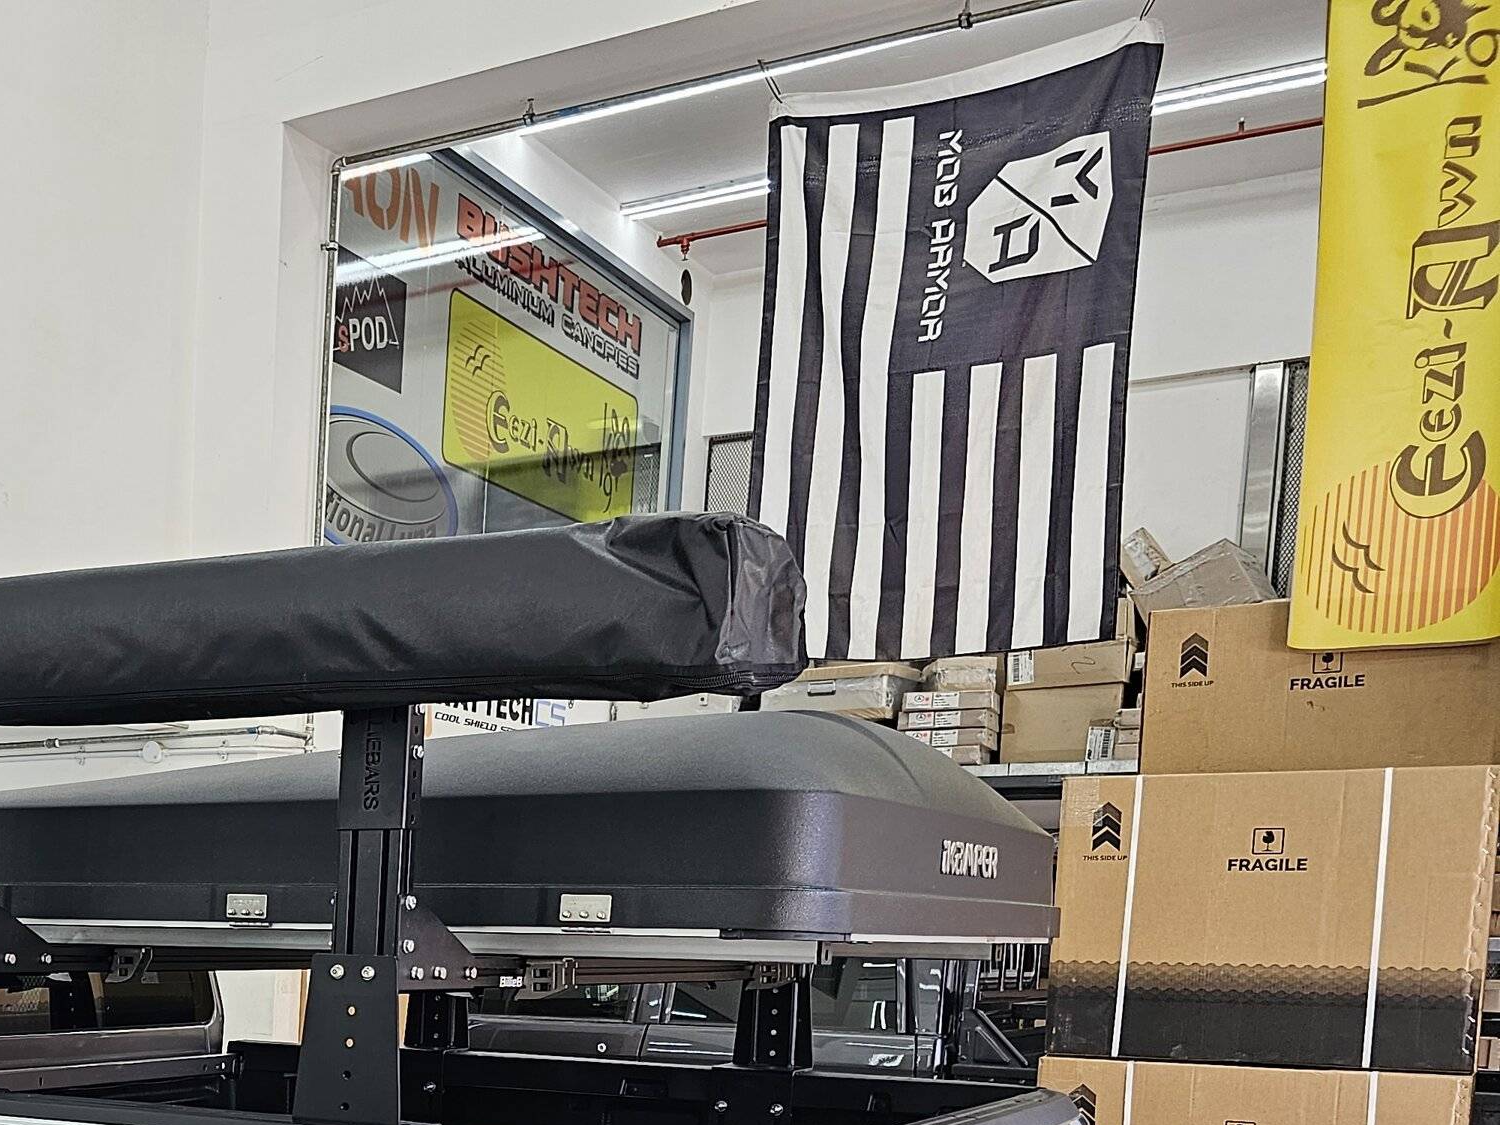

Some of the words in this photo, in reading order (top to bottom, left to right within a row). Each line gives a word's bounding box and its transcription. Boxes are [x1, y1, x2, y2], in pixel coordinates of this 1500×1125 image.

[933, 129, 963, 208] MOB
[457, 193, 643, 357] BUSHTECH
[917, 218, 956, 343] ARMOR
[455, 254, 555, 328] ALUMINIUM
[561, 312, 640, 380] CANOPIES
[1389, 114, 1500, 520] Eezi-Awn
[434, 711, 461, 725] COOL
[464, 718, 498, 732] SHIELD
[1187, 680, 1202, 688] SIDE
[1203, 679, 1214, 687] UP
[1289, 674, 1366, 691] FRAGILE
[1227, 858, 1308, 872] FRAGILE
